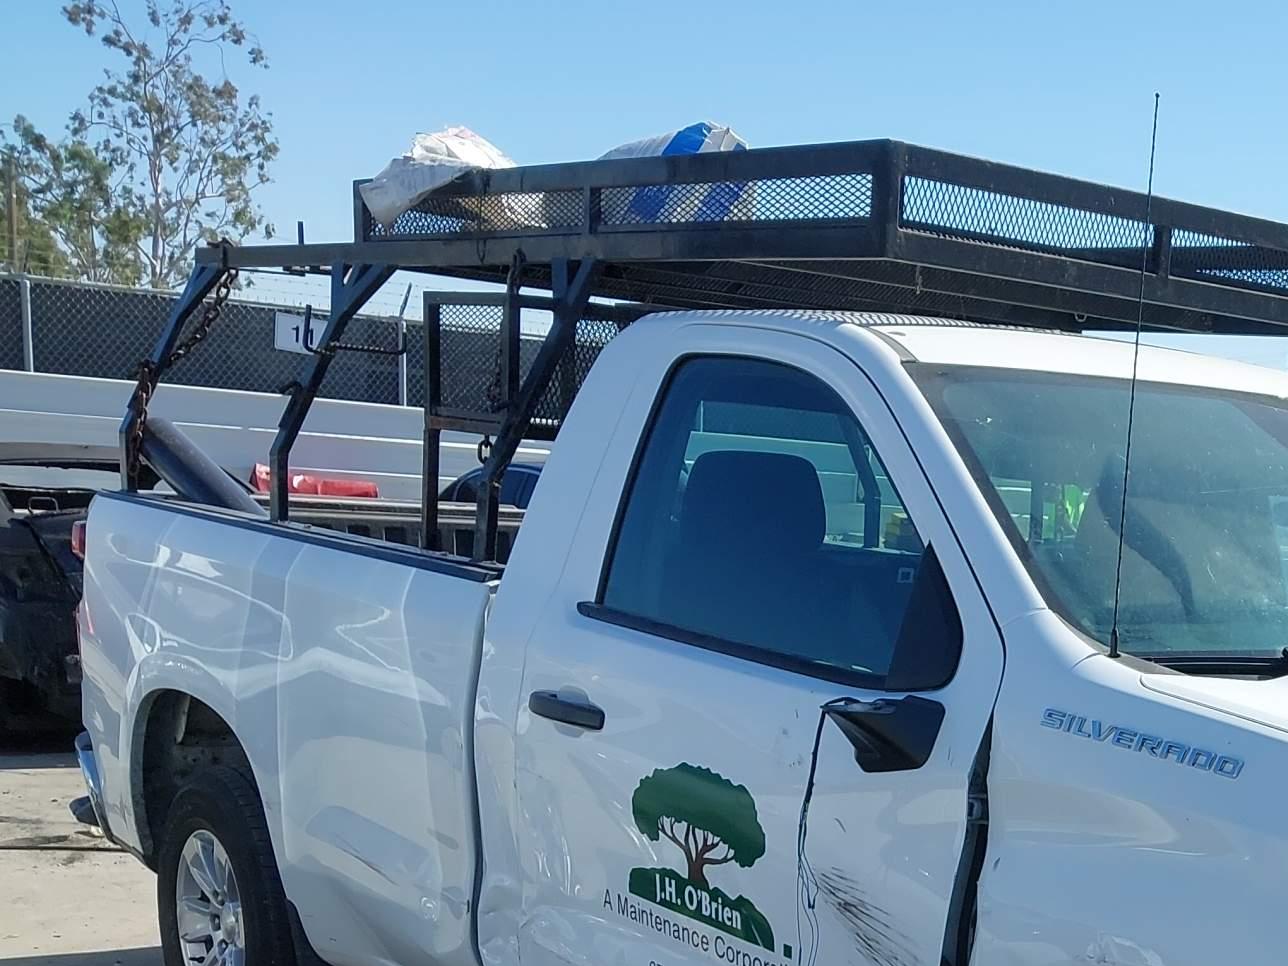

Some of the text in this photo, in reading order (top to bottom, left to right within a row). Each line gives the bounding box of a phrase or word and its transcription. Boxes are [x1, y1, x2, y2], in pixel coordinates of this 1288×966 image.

[1040, 708, 1245, 780] SILVERADO
[603, 888, 613, 912] A
[617, 894, 709, 952] Maintenance
[655, 873, 742, 930] J.H. O'Brien
